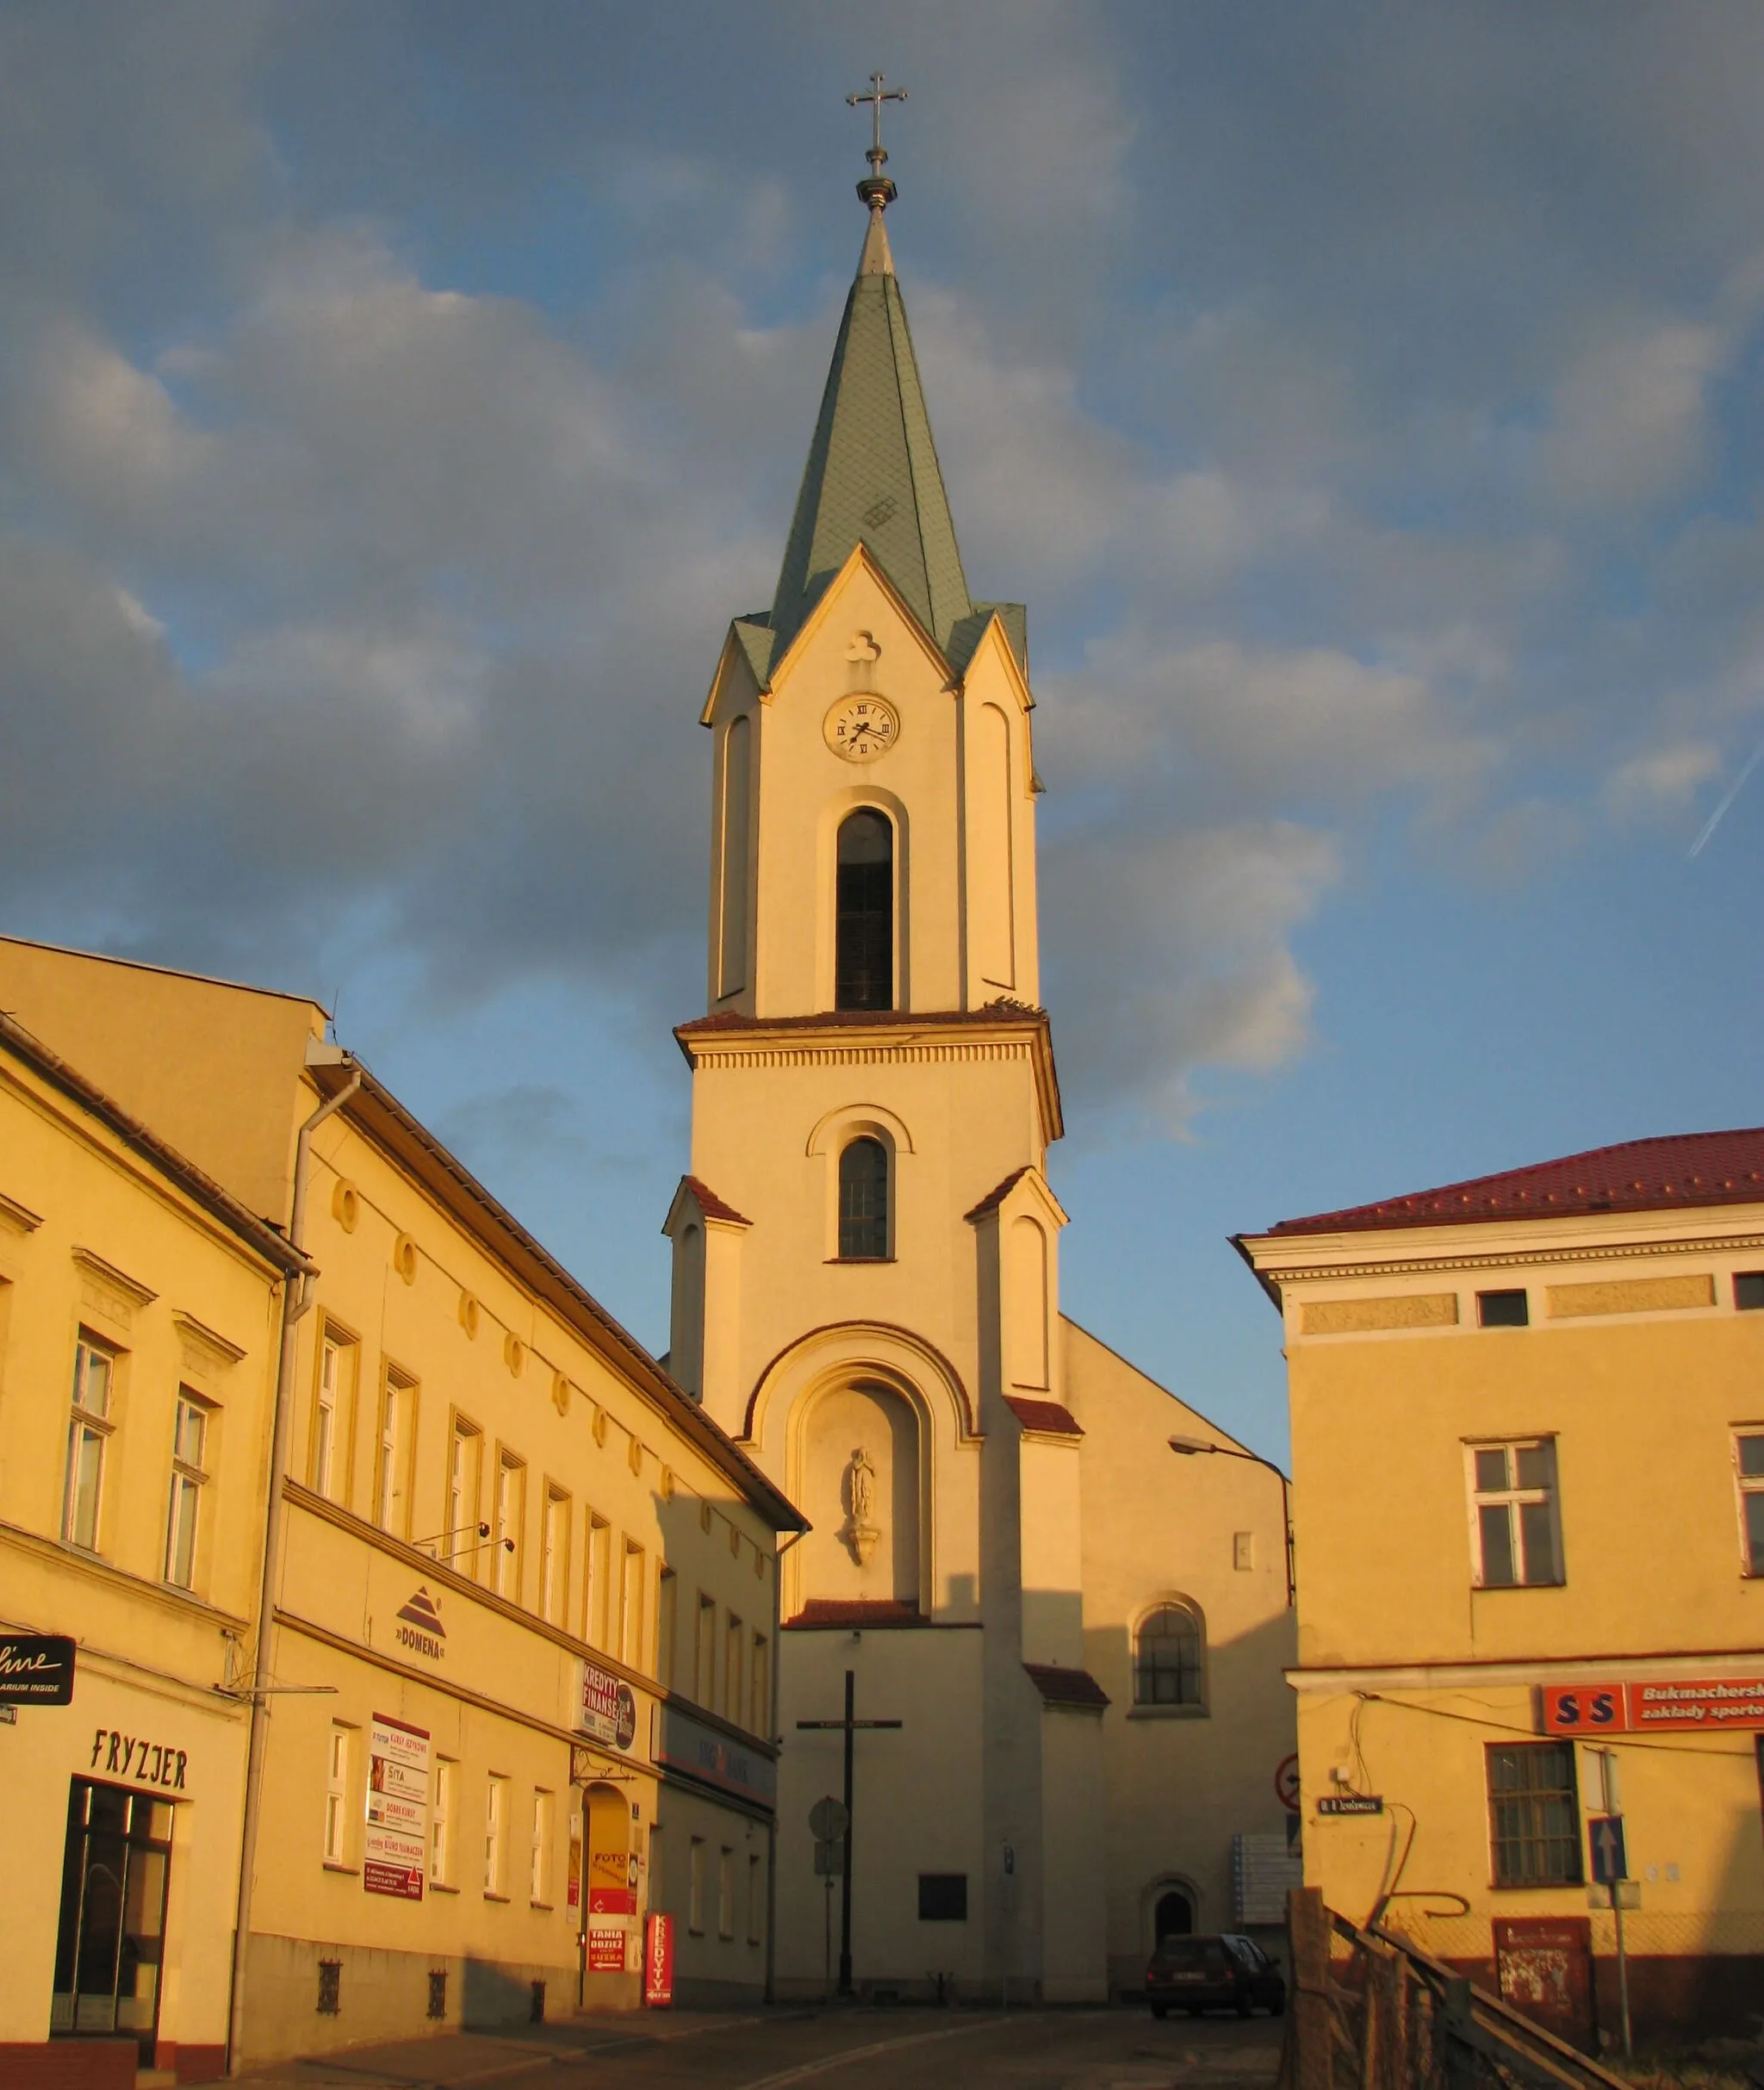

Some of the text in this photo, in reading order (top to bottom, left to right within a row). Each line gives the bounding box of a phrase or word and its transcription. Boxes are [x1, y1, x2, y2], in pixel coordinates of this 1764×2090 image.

[857, 706, 867, 714] XII
[837, 726, 845, 736] IX
[30, 1683, 59, 1692] INSIDE
[584, 1663, 618, 1699] KREDYTY
[583, 1686, 618, 1720] FINANSE
[1641, 1705, 1706, 1720] zakłady
[91, 1728, 188, 1788] FRYZJER
[699, 1740, 748, 1783] ING BANK
[594, 1853, 625, 1863] FOTO
[592, 1930, 623, 1938] TANIA
[653, 1913, 666, 1990] KREDYTY
